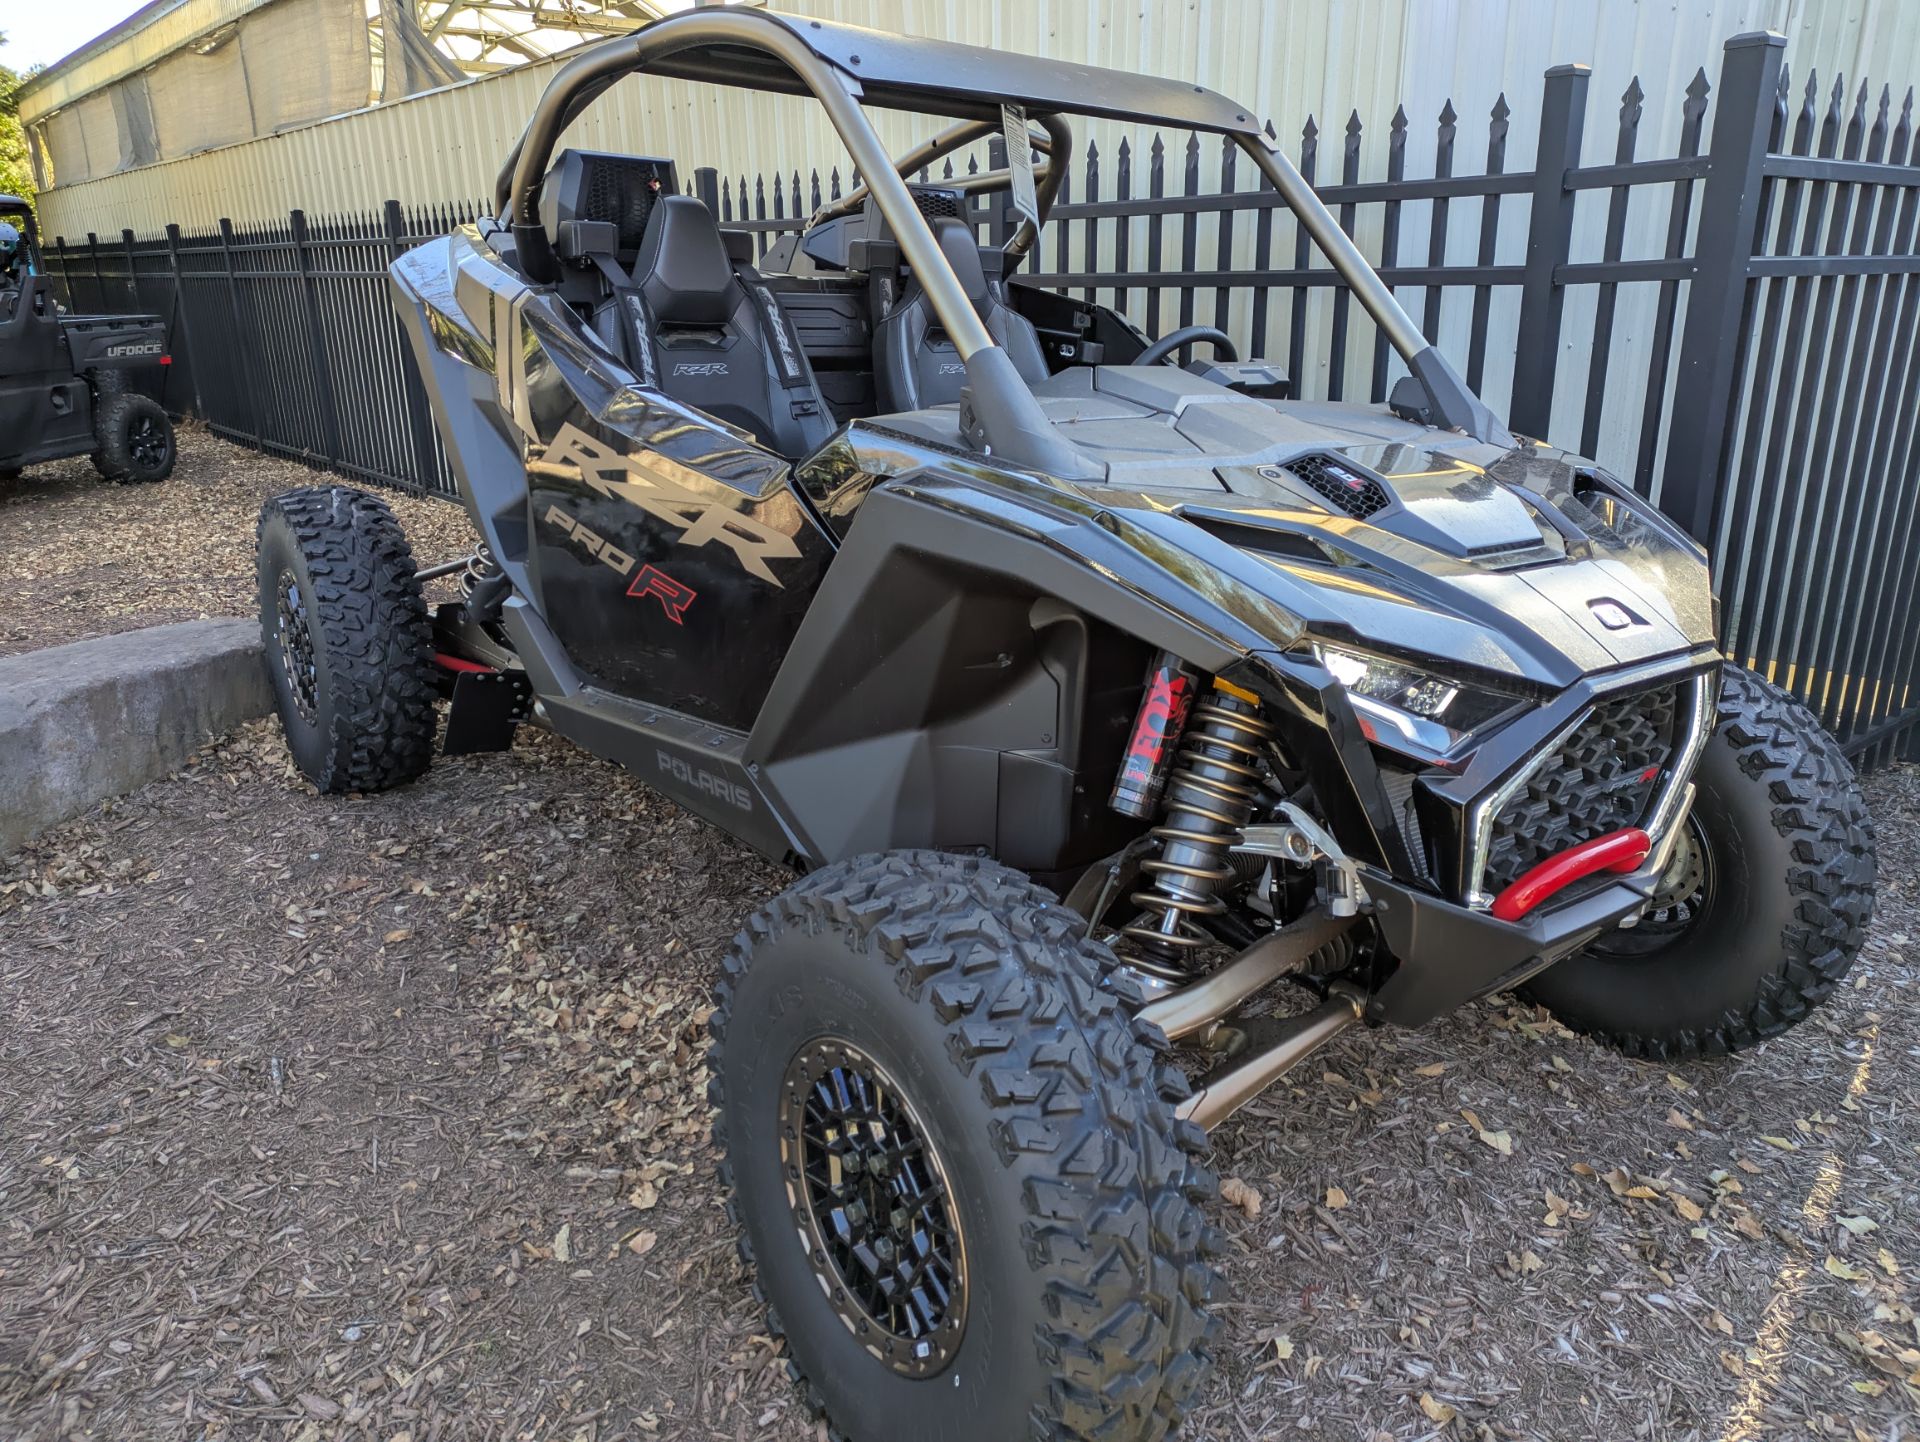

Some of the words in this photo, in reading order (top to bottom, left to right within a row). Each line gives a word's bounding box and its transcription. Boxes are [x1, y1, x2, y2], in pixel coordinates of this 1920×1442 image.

[107, 343, 163, 357] UFORCE
[672, 362, 729, 376] RZR
[939, 363, 967, 375] RZ
[541, 421, 803, 589] RZR
[544, 504, 637, 576] PRO
[626, 563, 698, 626] R
[1127, 669, 1189, 764] FOX
[656, 748, 753, 812] POLARIS
